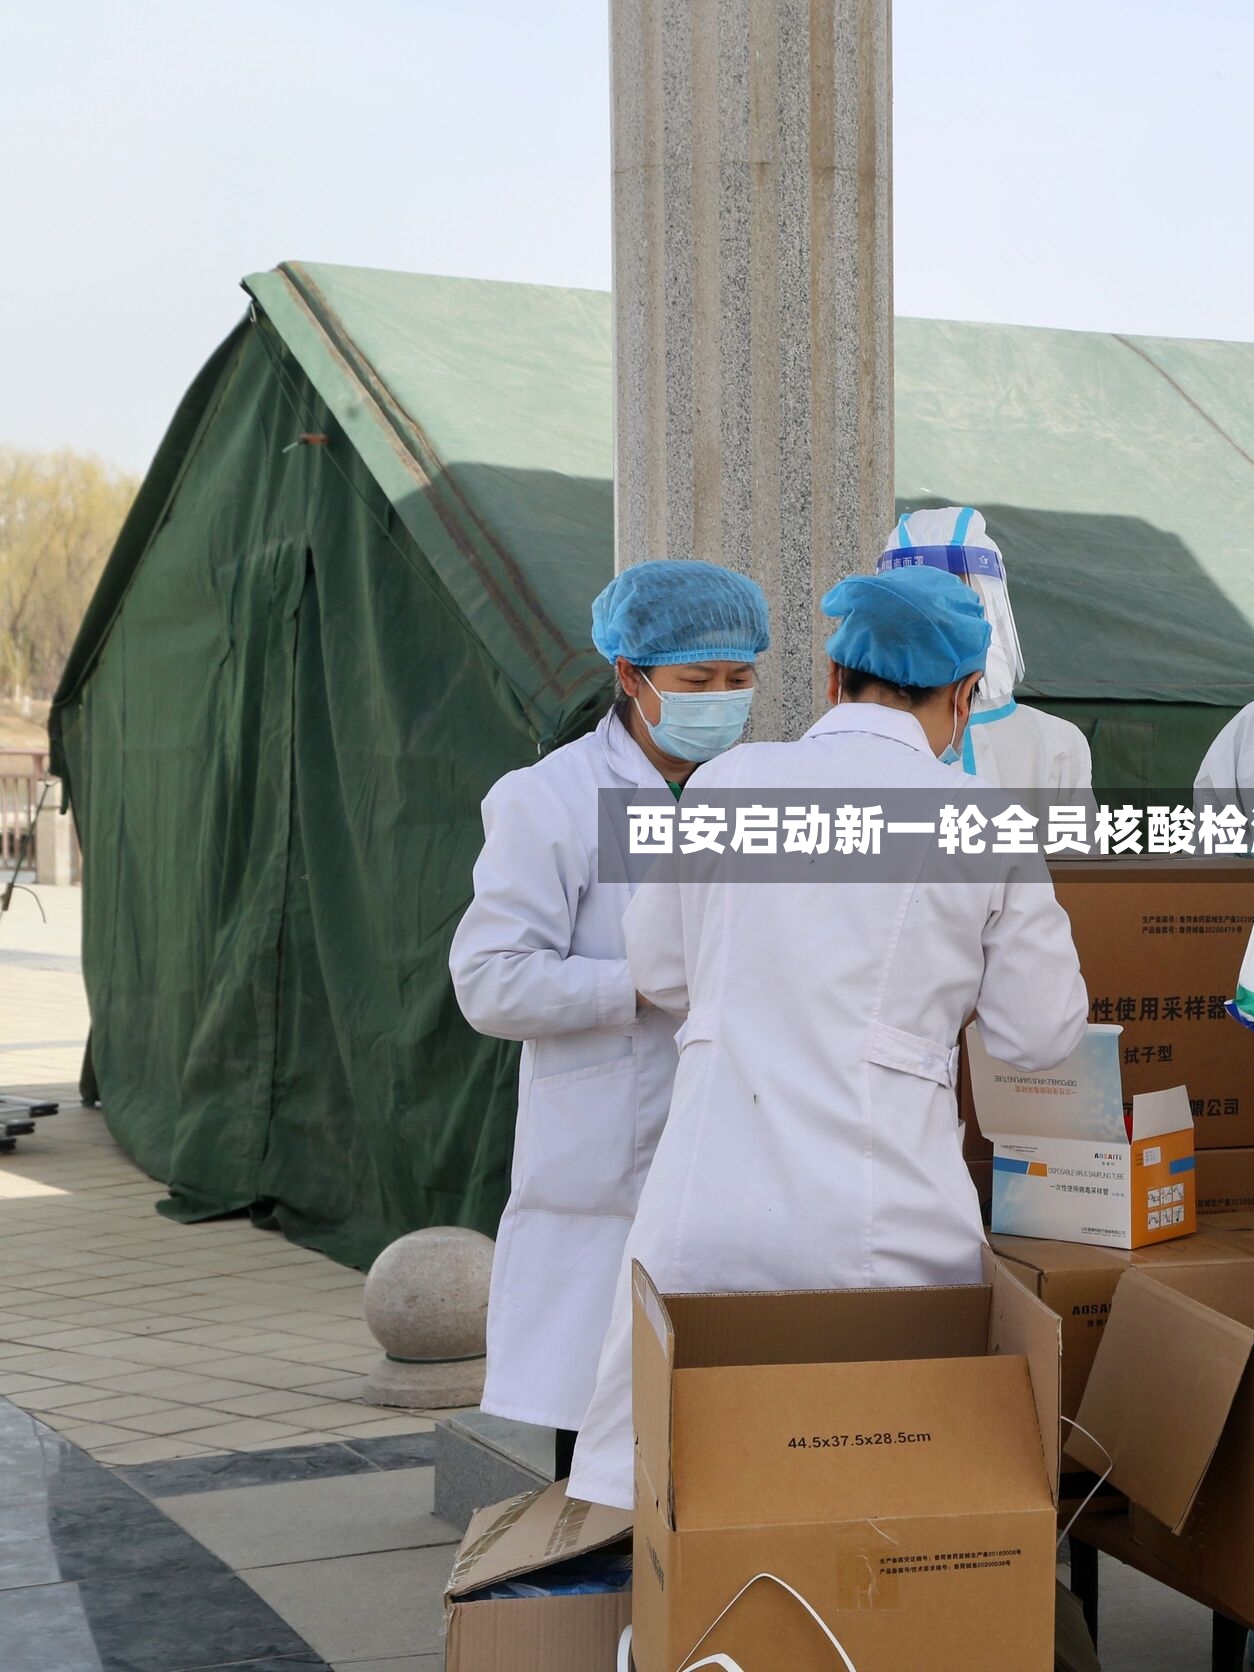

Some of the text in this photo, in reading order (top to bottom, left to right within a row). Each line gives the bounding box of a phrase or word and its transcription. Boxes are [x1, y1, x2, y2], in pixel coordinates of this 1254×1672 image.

[1124, 1044, 1173, 1064] 拭子型
[1048, 1167, 1125, 1180] DISPOSABLE VIRUS SAMPLING TUBE
[1050, 1184, 1109, 1196] 一次性使用病毒采样管
[787, 1431, 931, 1449] 44.5x37.5x28.5cm
